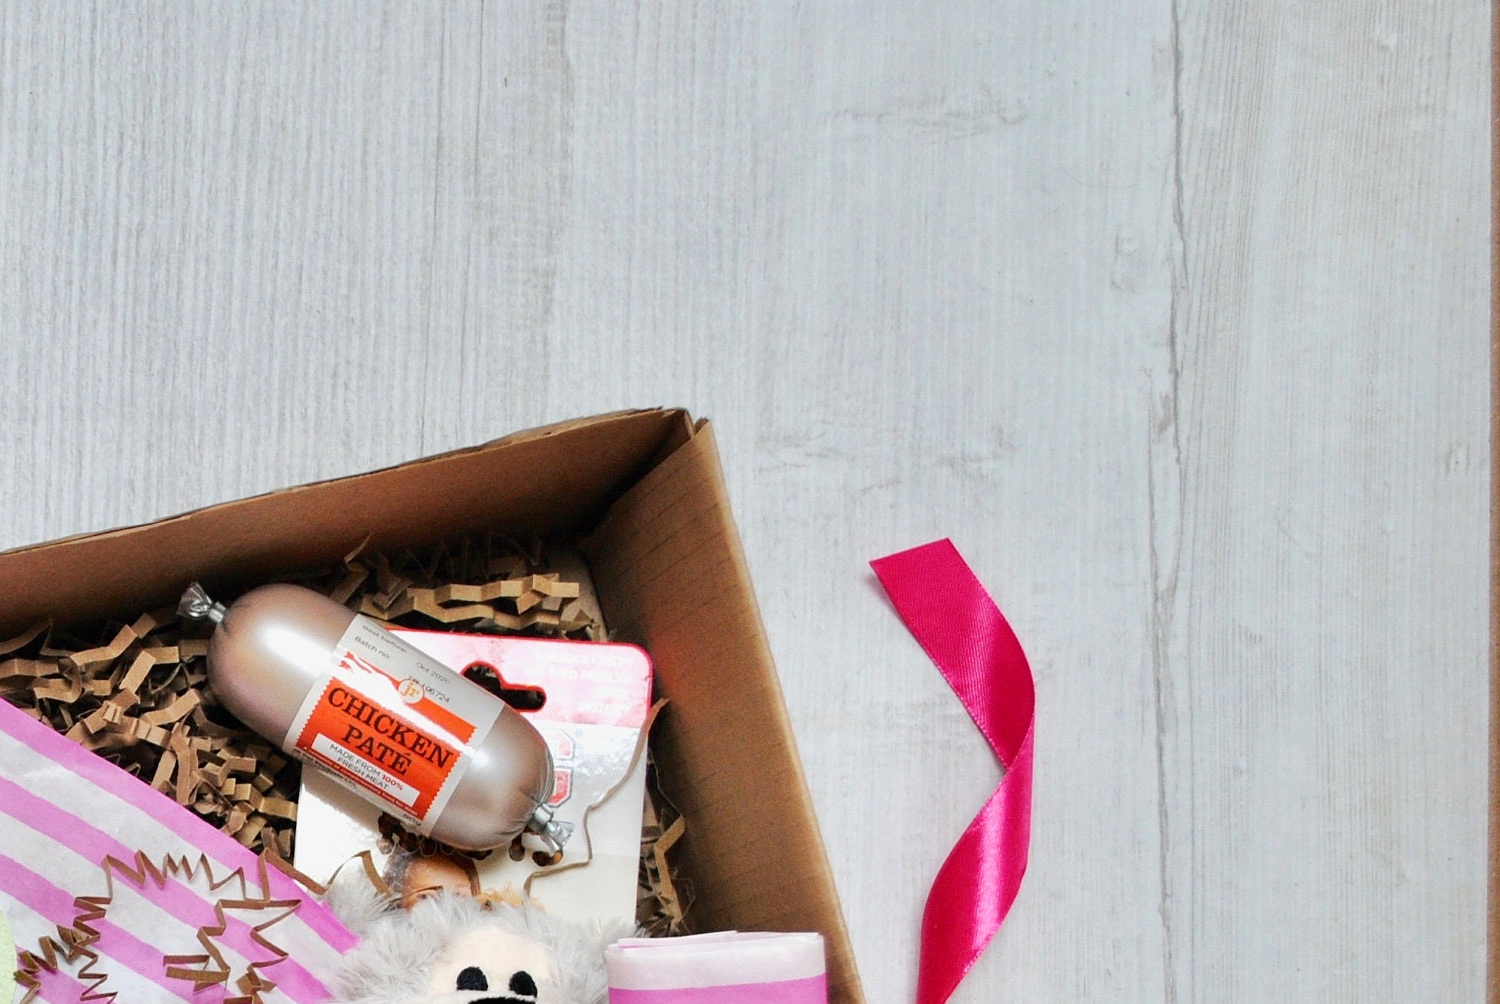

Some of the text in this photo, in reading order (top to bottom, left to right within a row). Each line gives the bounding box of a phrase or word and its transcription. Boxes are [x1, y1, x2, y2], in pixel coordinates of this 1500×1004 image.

[355, 636, 378, 652] Batch
[328, 687, 454, 768] CHICKEN
[342, 724, 412, 776] PATÉ
[330, 744, 356, 762] MADE
[356, 757, 381, 776] FROM
[382, 774, 403, 791] 100%
[337, 757, 364, 778] FRESH
[366, 773, 388, 790] MEAT
